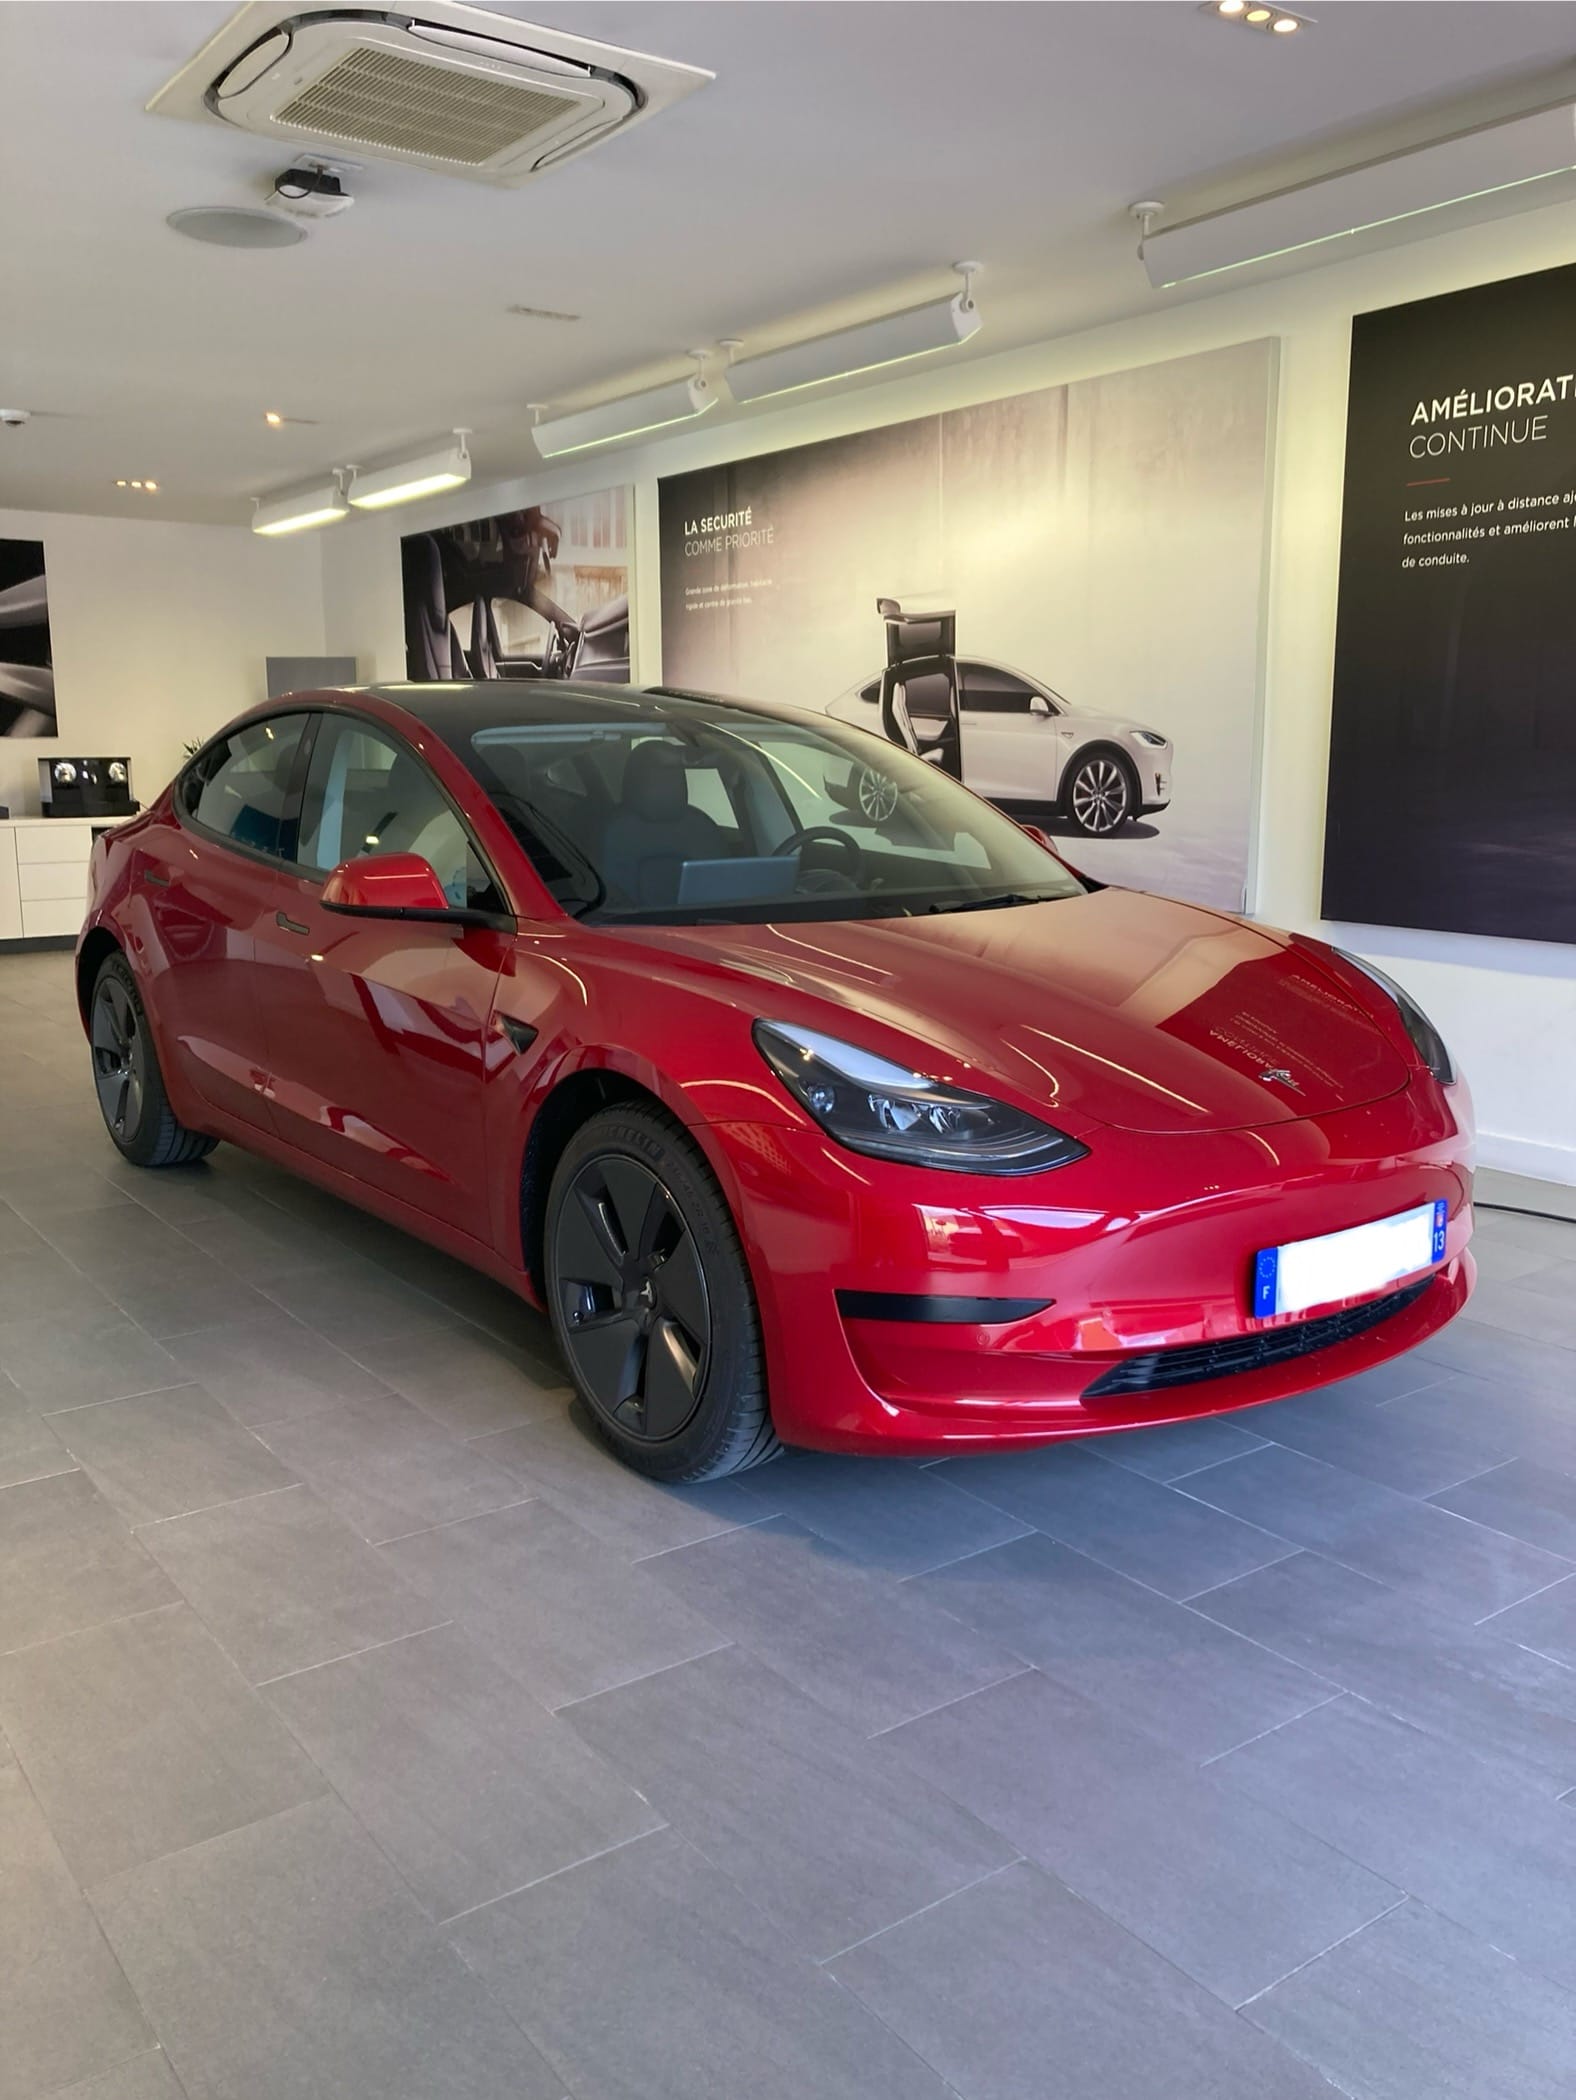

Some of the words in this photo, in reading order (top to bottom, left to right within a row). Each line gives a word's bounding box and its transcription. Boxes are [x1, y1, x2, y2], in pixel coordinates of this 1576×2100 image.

[1409, 415, 1549, 459] CONTINUE
[684, 520, 698, 536] LA
[700, 506, 753, 533] SECURITÉ
[1404, 509, 1423, 522] Les
[1426, 506, 1458, 519] mises
[1460, 502, 1468, 515] à
[1470, 500, 1495, 517] jour
[1497, 498, 1505, 512] à
[1507, 491, 1559, 510] distance
[684, 536, 722, 557] COMME
[725, 525, 775, 550] PRIORITÉ
[1403, 526, 1485, 545] fonctionnalités
[1488, 525, 1501, 537] et
[1503, 517, 1569, 535] améliorent
[1402, 556, 1416, 569] de
[1418, 552, 1470, 568] conduite.
[1433, 1230, 1445, 1252] 13
[1262, 1285, 1271, 1300] F
